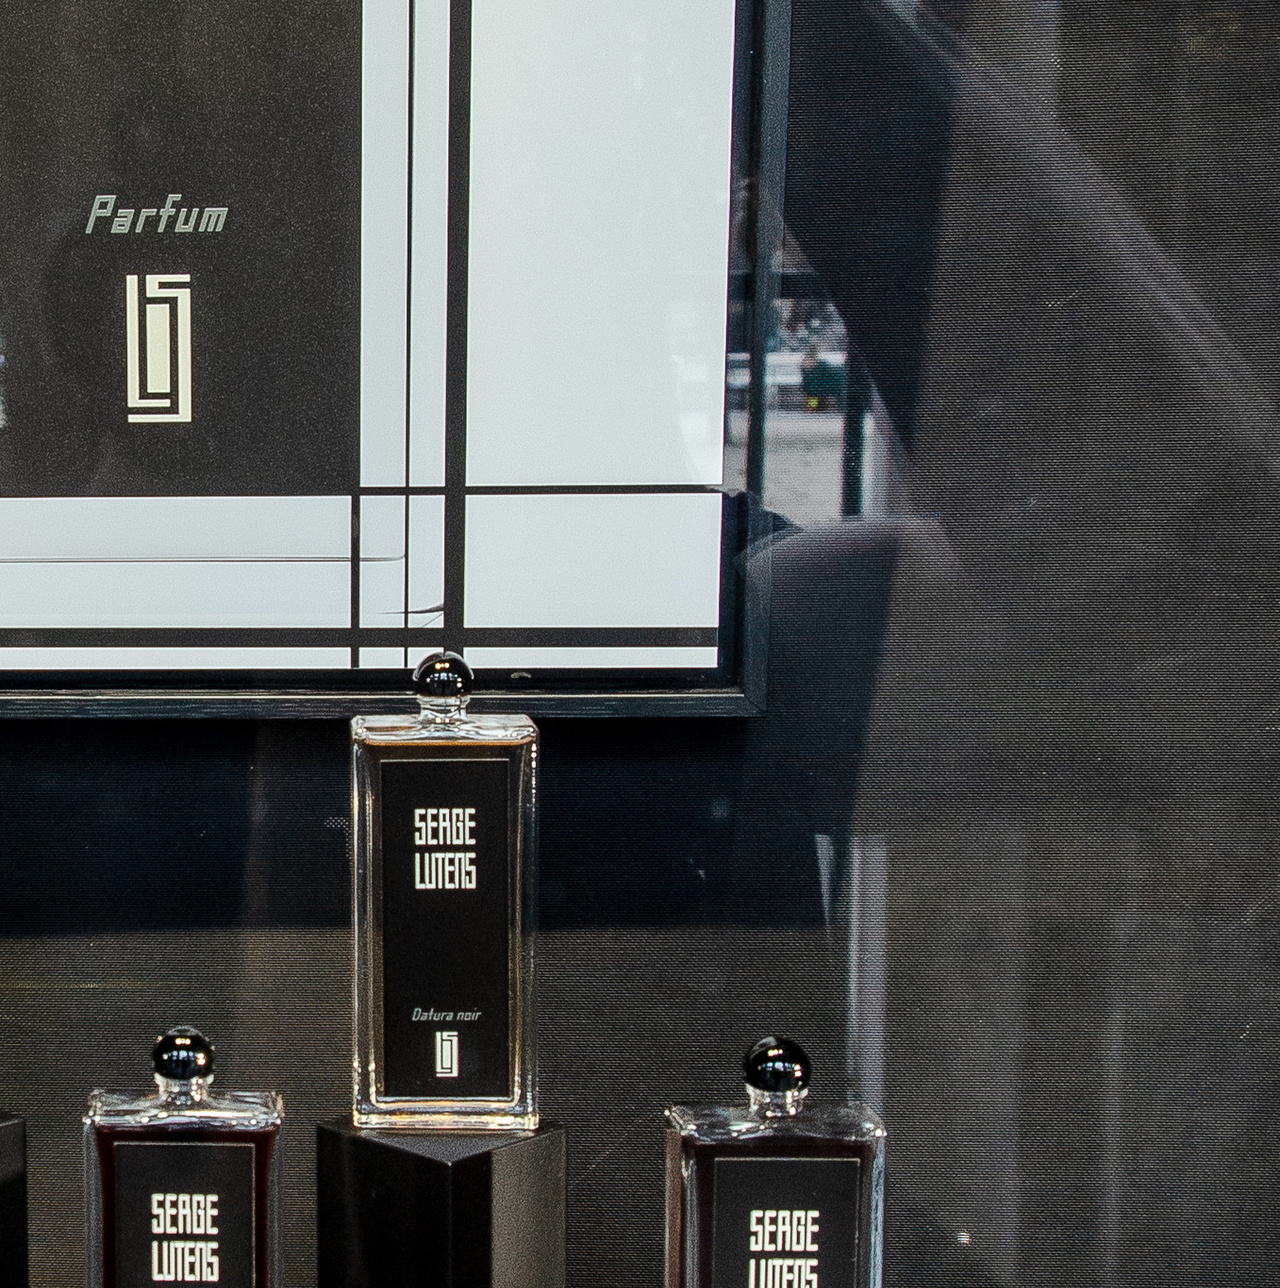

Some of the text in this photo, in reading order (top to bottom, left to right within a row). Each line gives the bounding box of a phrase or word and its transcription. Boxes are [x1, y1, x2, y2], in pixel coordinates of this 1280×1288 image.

[85, 194, 228, 234] Parfum
[414, 808, 476, 845] SERGE
[414, 852, 477, 890] LUTENS
[412, 1007, 482, 1021] Datura noir
[151, 1193, 219, 1235] SERGE
[750, 1210, 820, 1252] SERGE
[151, 1240, 219, 1282] LUTENS
